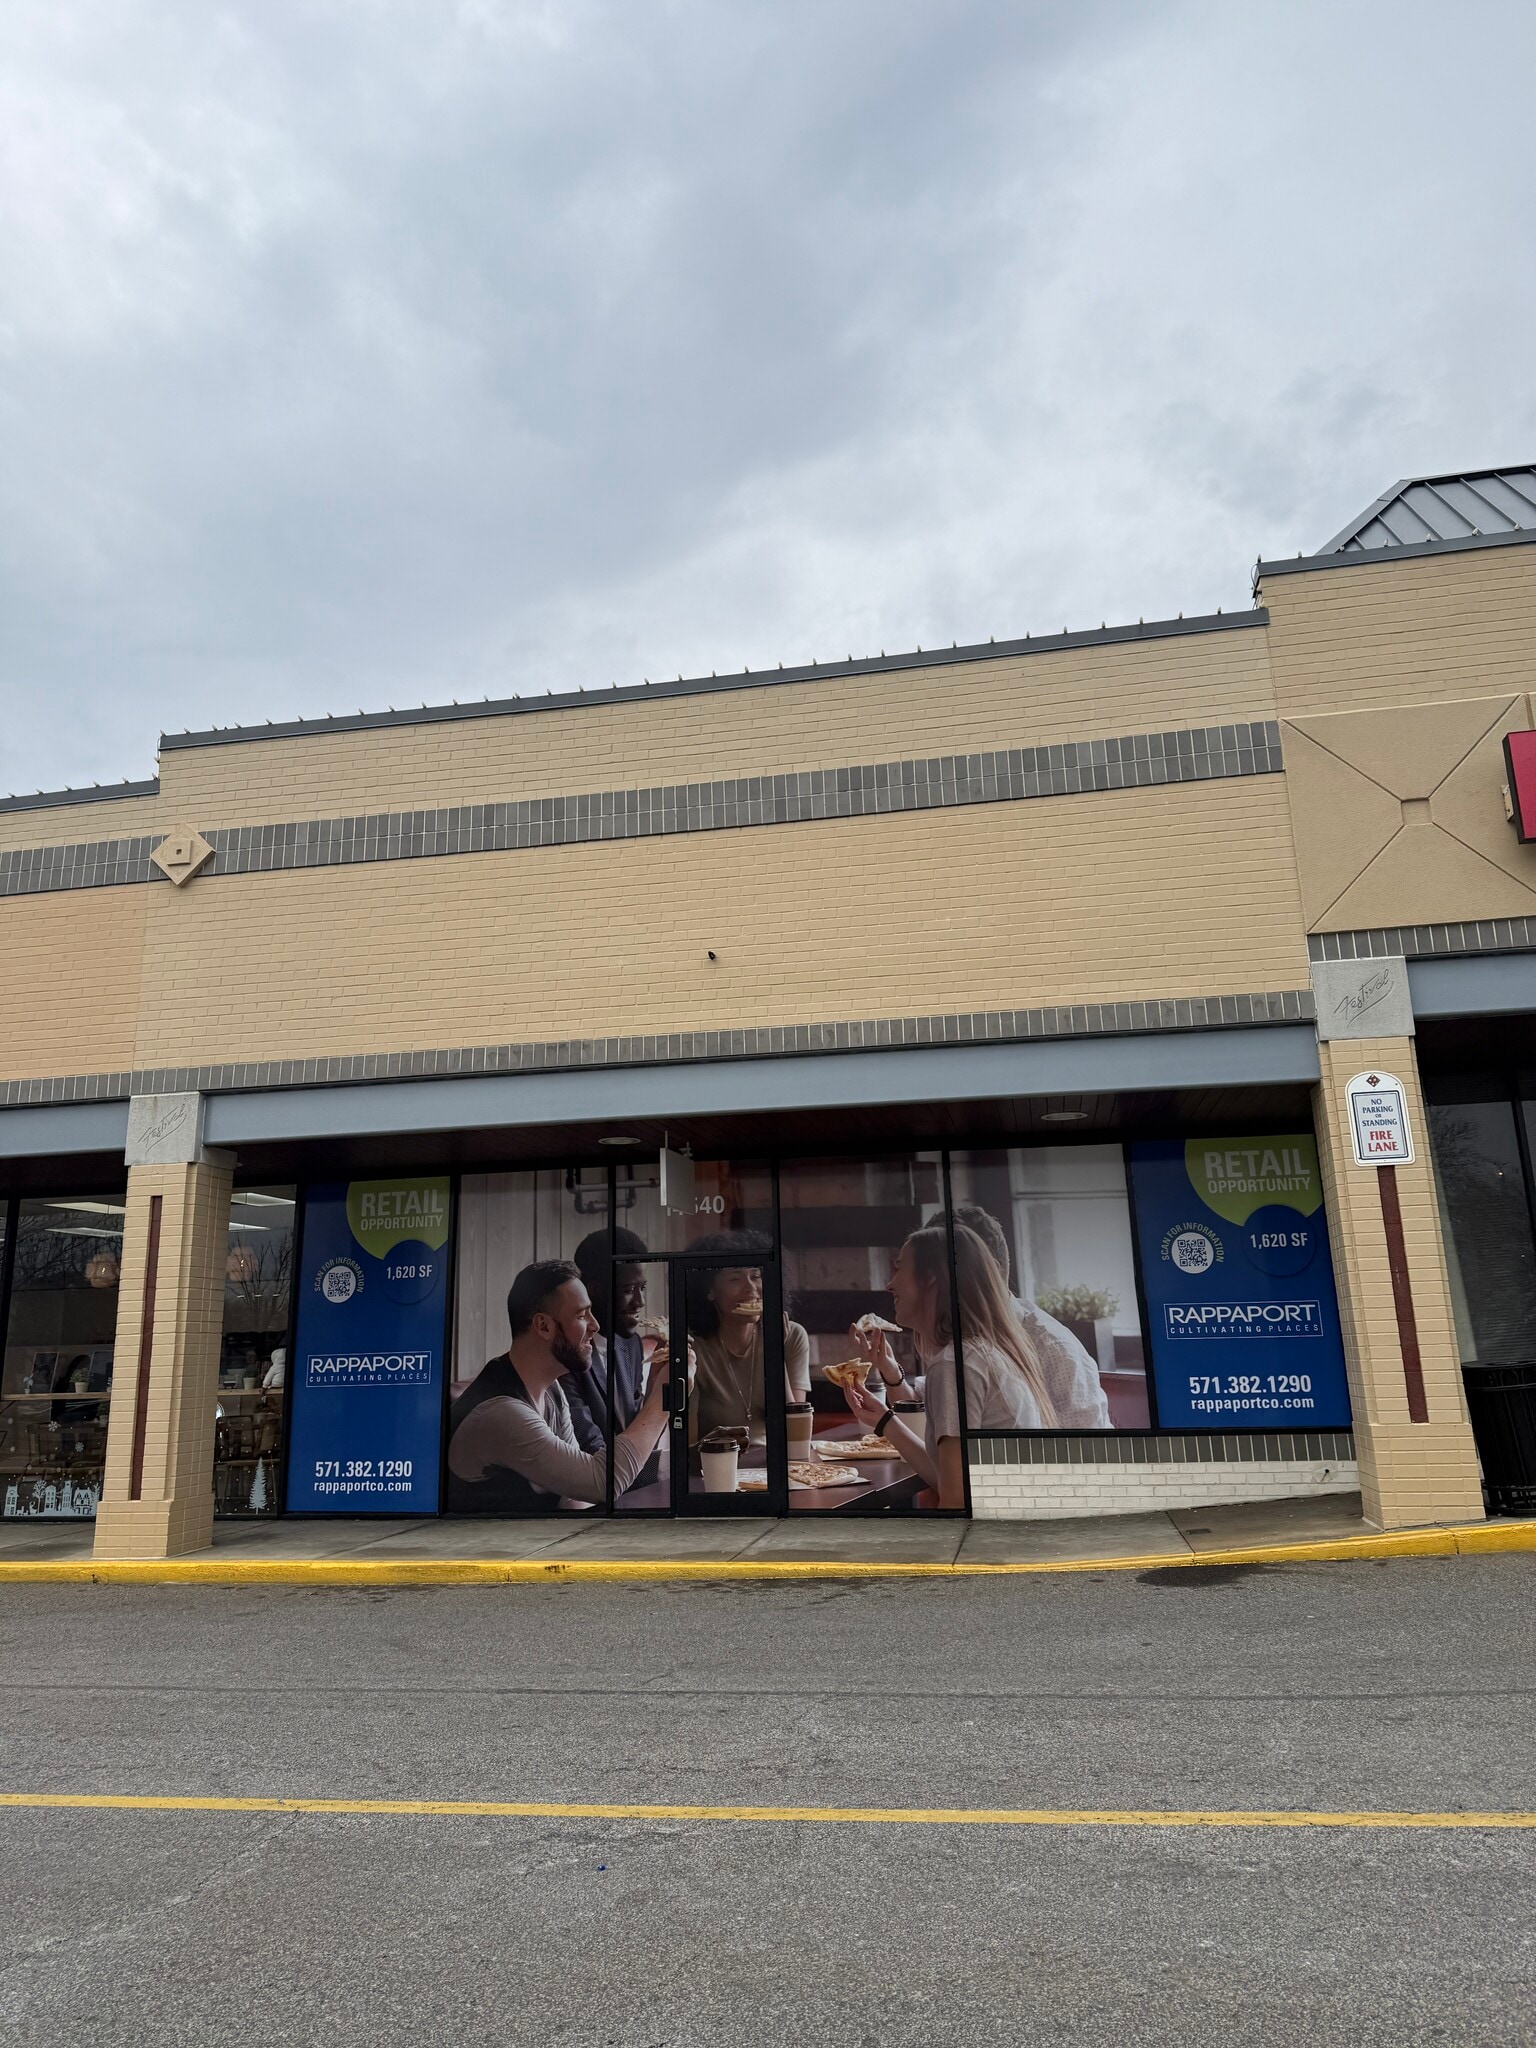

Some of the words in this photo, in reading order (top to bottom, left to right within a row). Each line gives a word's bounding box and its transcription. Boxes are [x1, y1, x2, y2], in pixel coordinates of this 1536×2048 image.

[1334, 969, 1389, 1020] Festival
[1369, 1130, 1394, 1140] FIRE
[1368, 1142, 1399, 1152] LANE
[1204, 1148, 1310, 1178] RETAIL
[1208, 1177, 1311, 1194] OPPORTUNITY
[361, 1189, 443, 1217] RETAIL
[360, 1215, 443, 1231] OPPORTUNITY
[1161, 1237, 1171, 1261] SCAN
[1167, 1224, 1183, 1238] FOR
[1183, 1221, 1224, 1263] INFORMATION
[1250, 1233, 1287, 1250] 1,620
[1291, 1232, 1308, 1247] SF
[314, 1270, 324, 1292] SCAN
[321, 1259, 335, 1271] FOR
[335, 1256, 365, 1293] INFORMATION
[386, 1265, 415, 1281] 1,620
[419, 1264, 432, 1278] SF
[1168, 1304, 1316, 1324] RAPPAPORT
[1170, 1325, 1262, 1334] CULTIVATING
[1268, 1324, 1319, 1332] PLACES
[310, 1354, 428, 1374] RAPPAPORT
[309, 1374, 382, 1383] CULTIVATING
[387, 1372, 428, 1381] PLACES
[1189, 1374, 1312, 1395] 571.382.1290
[1191, 1397, 1315, 1413] rappaportco.com
[315, 1460, 413, 1478] 571.382.1290
[314, 1480, 412, 1494] rappaportco.com
